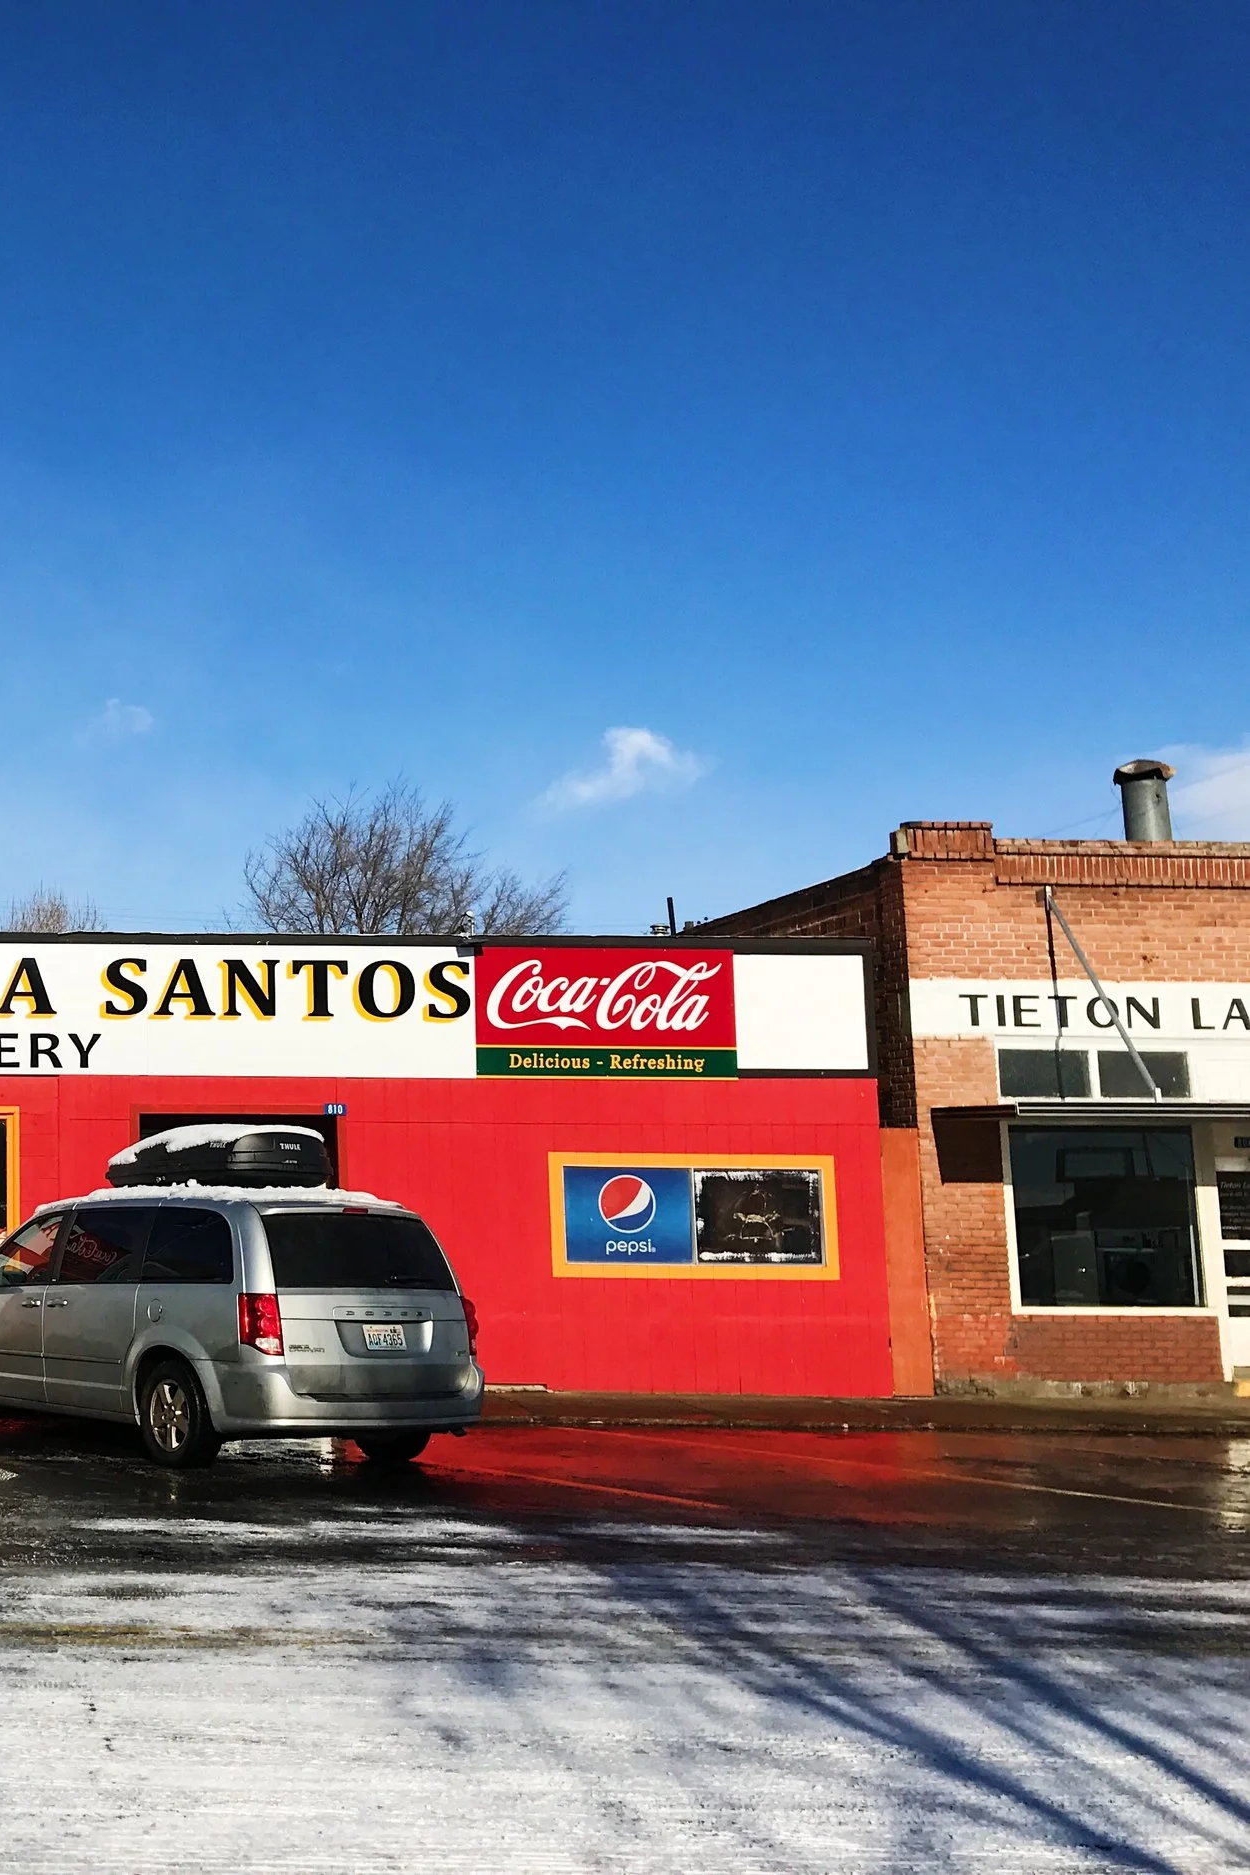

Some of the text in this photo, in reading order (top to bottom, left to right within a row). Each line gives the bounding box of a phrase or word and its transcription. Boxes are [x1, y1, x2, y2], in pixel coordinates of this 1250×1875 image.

[100, 957, 472, 1023] SANTOS
[486, 959, 723, 1031] Coca-Cola
[958, 994, 1161, 1029] TIETON
[509, 1053, 590, 1070] Delicious
[610, 1054, 705, 1073] Refreshing
[327, 1104, 343, 1114] 810
[279, 1143, 301, 1151] THULE
[605, 1238, 653, 1256] pepsi
